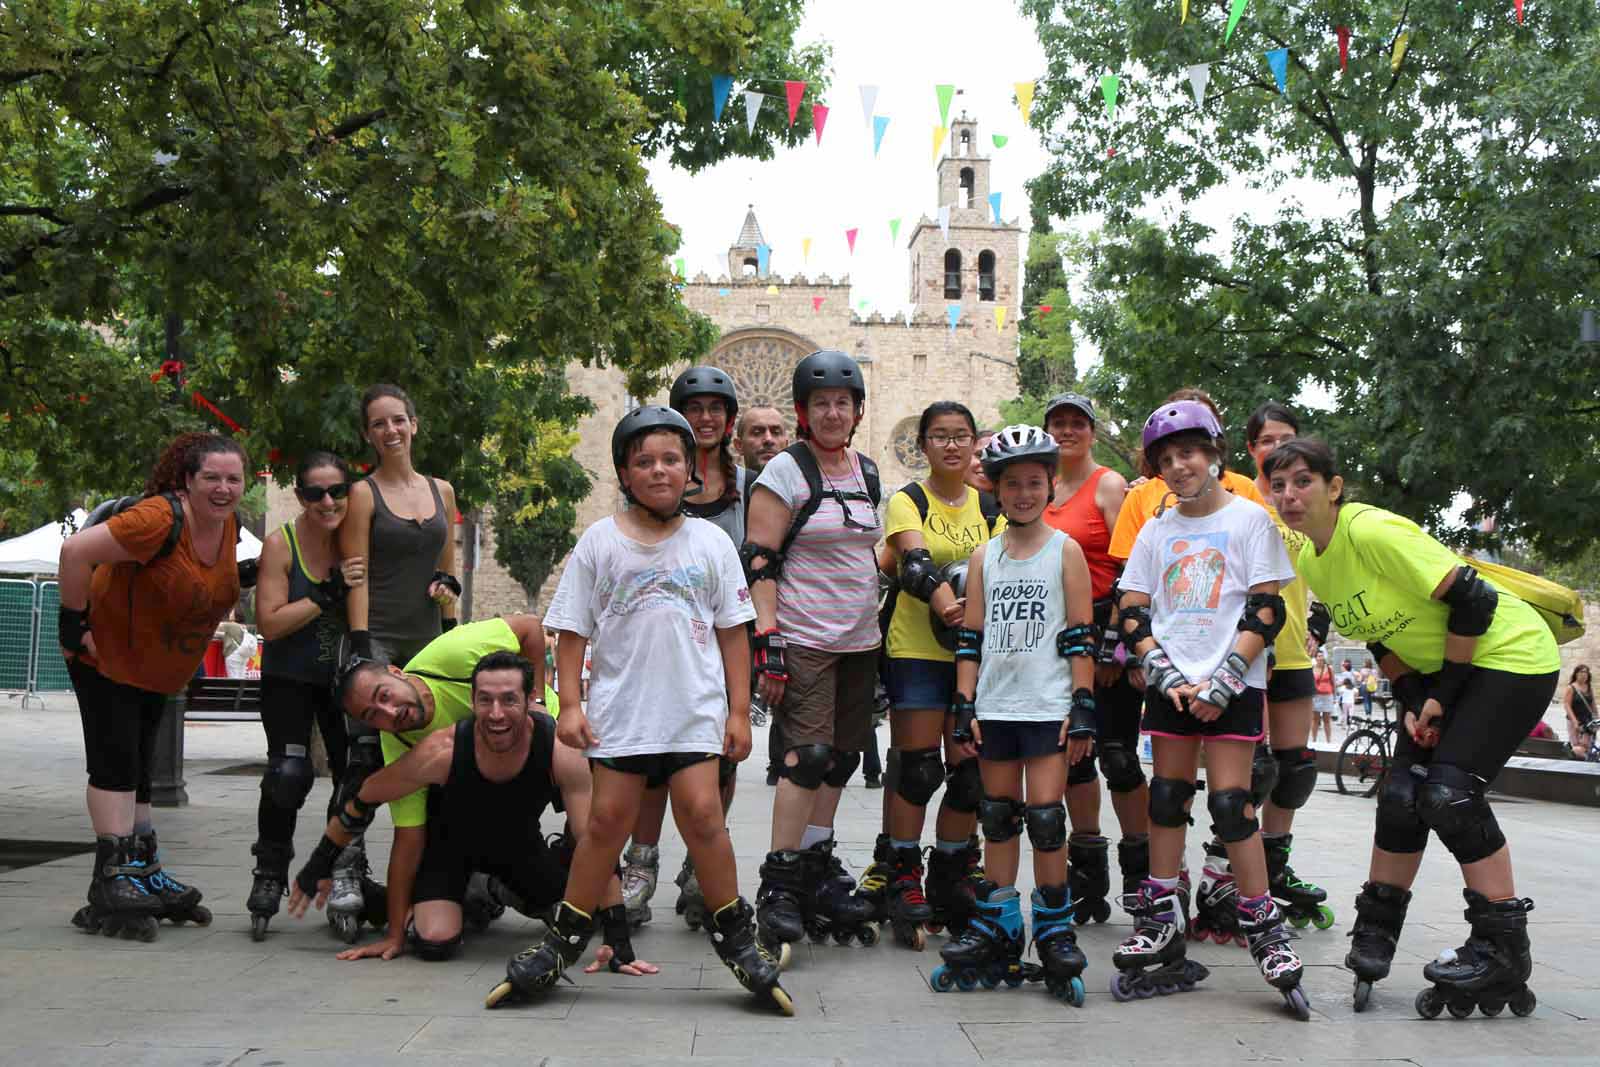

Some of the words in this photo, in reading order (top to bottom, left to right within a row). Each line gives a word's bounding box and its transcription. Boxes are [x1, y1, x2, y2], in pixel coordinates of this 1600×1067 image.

[992, 584, 1049, 601] never
[991, 601, 1045, 622] EVER
[988, 622, 1016, 649] GIVE
[1025, 622, 1045, 648] UP
